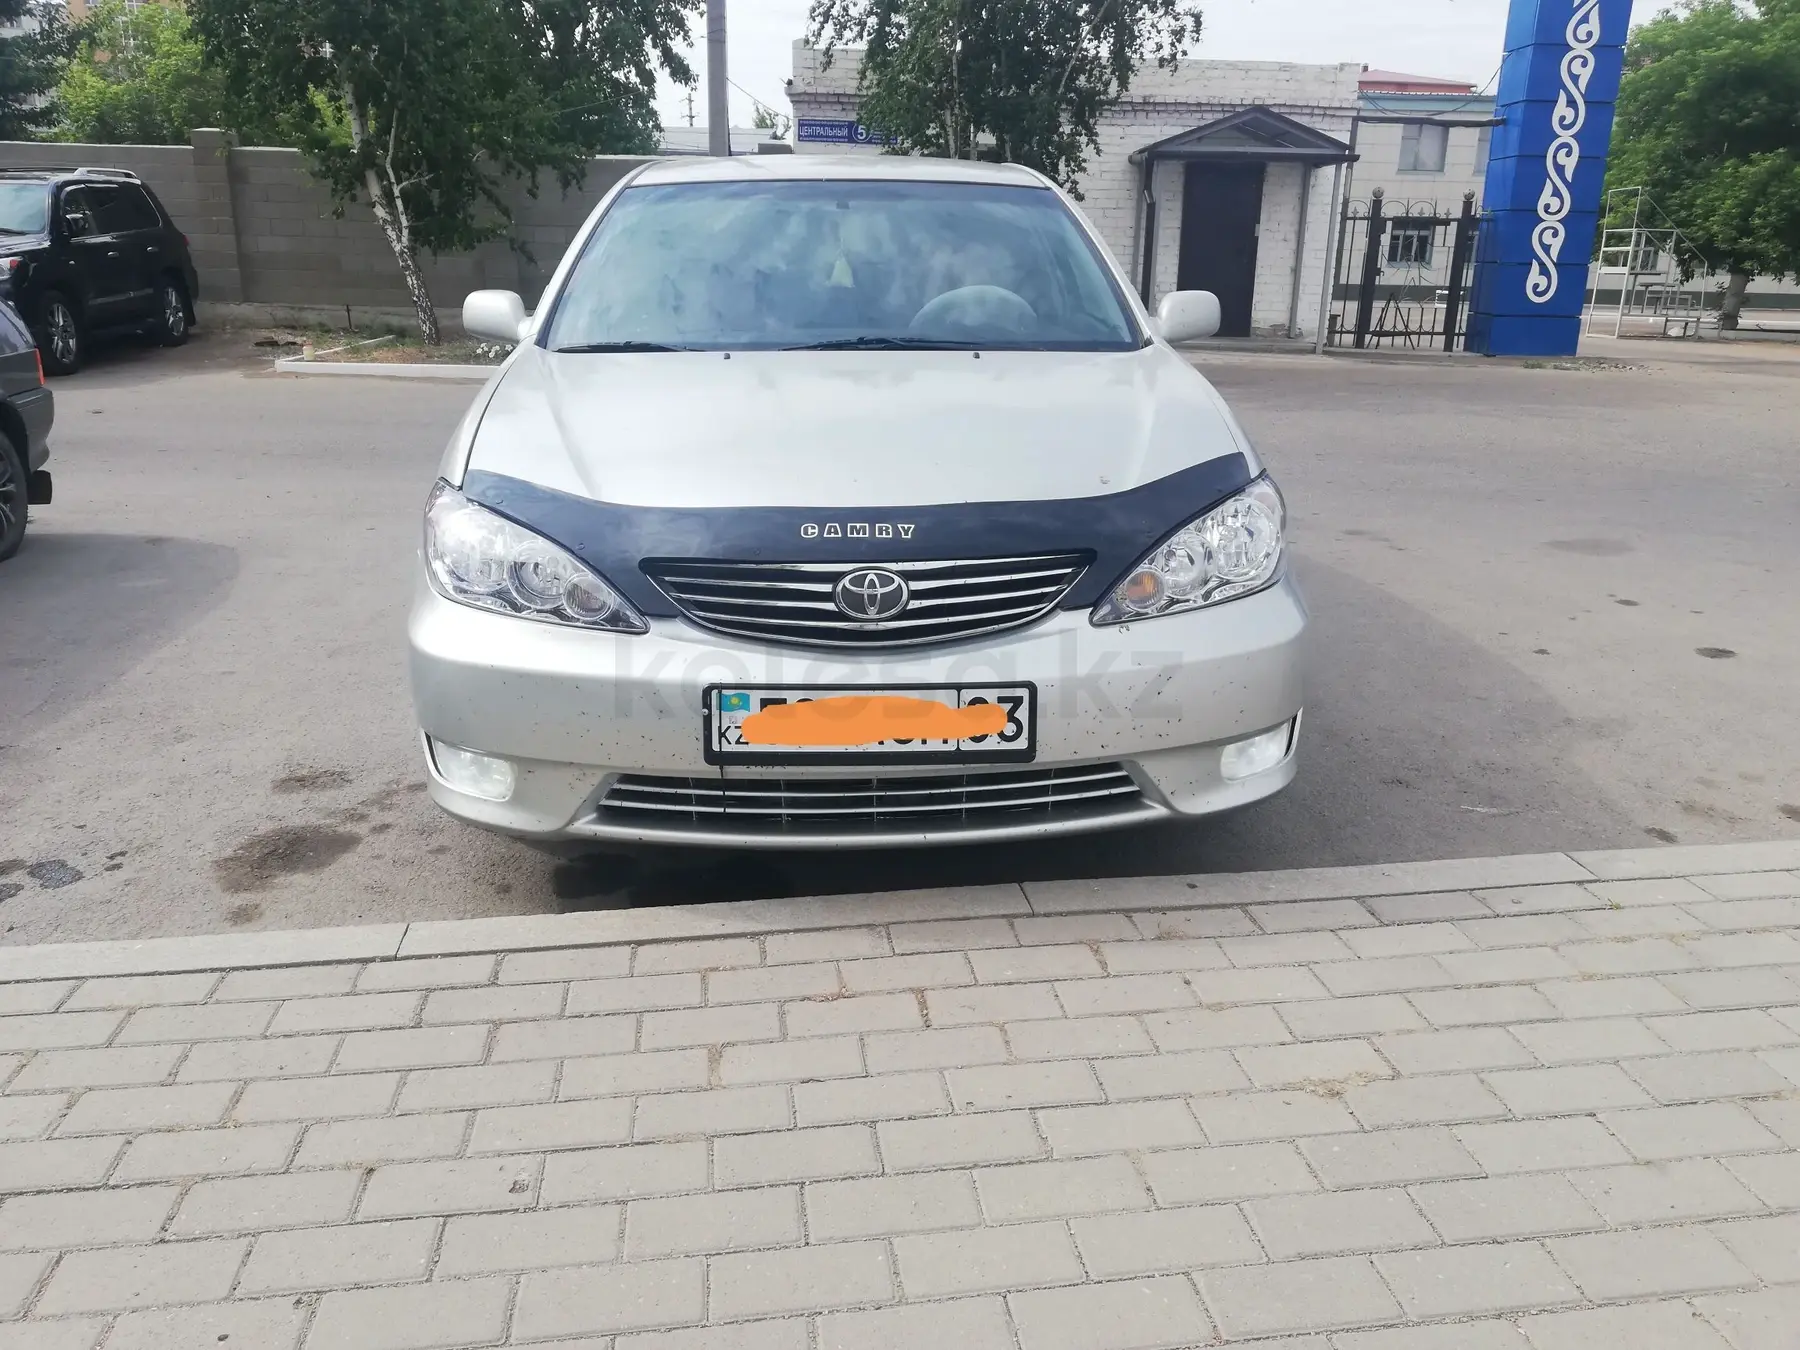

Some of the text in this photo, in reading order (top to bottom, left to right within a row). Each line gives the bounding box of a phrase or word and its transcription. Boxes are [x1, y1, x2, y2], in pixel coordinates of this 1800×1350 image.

[799, 126, 849, 137] ЦЕНТРАЛЬНЫЙ
[857, 125, 867, 140] 5
[800, 523, 915, 538] CAMRY
